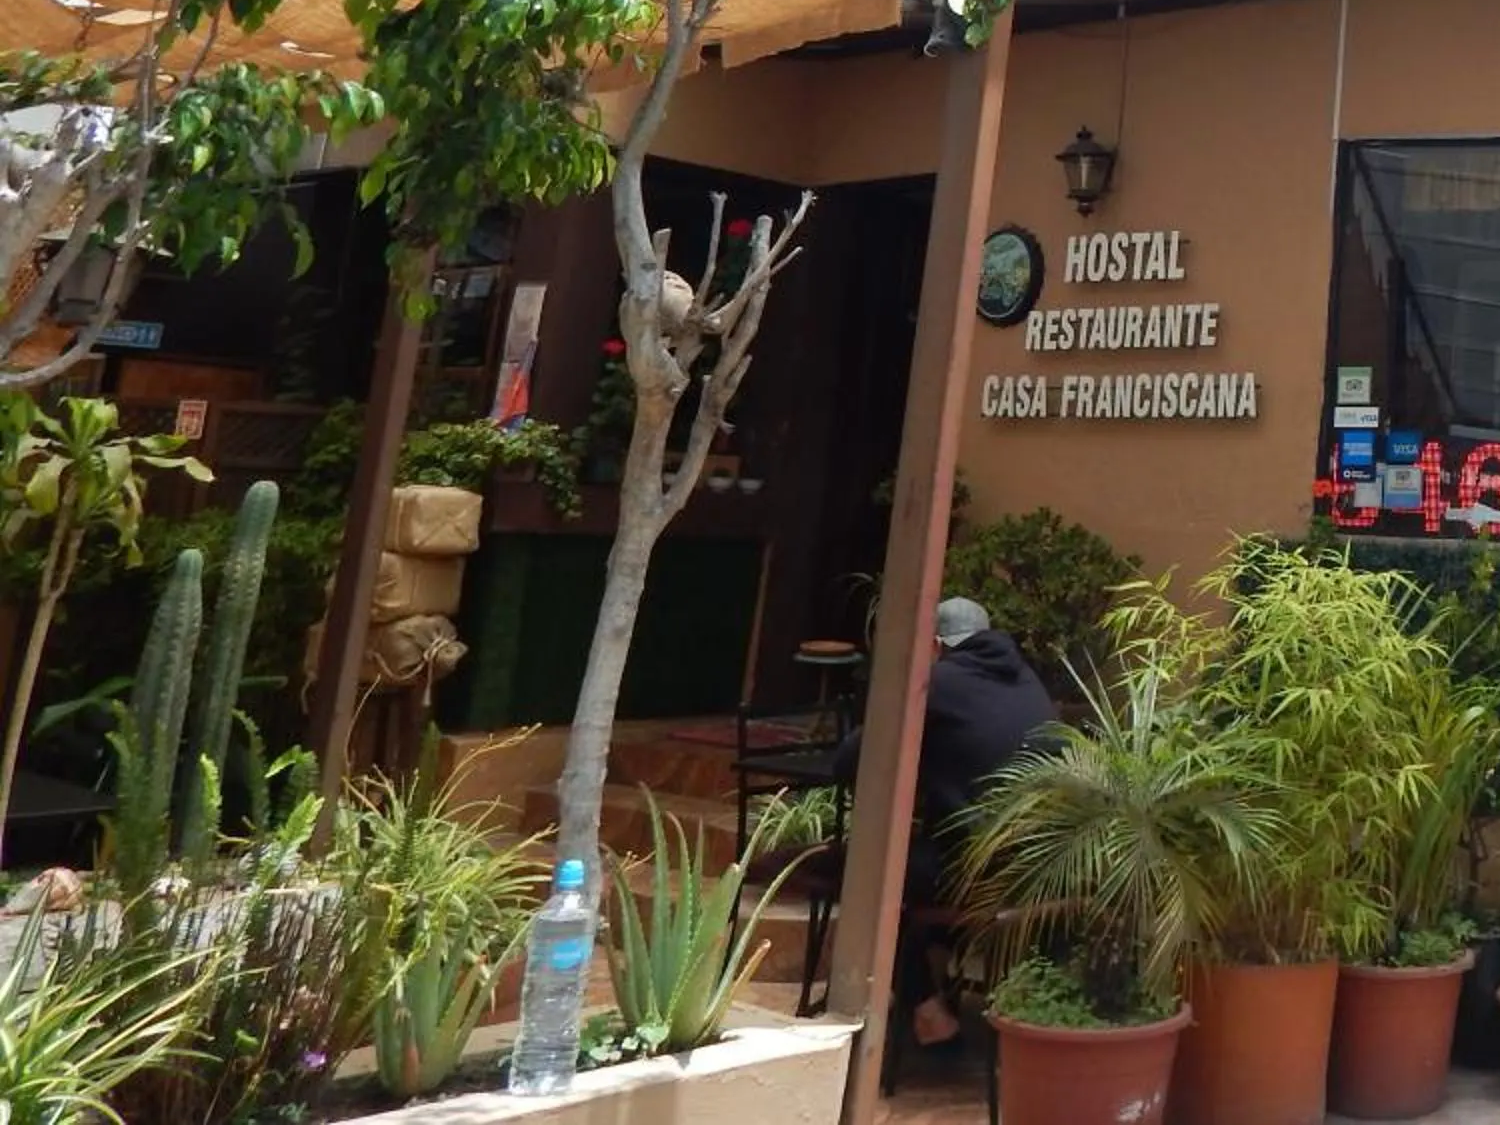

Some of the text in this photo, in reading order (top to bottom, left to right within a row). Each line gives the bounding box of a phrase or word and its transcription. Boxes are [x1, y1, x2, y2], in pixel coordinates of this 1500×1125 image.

[1063, 230, 1185, 283] HOSTAL
[1025, 303, 1219, 351] RESTAURANTE
[981, 372, 1258, 419] CASA FRANCISCANA
